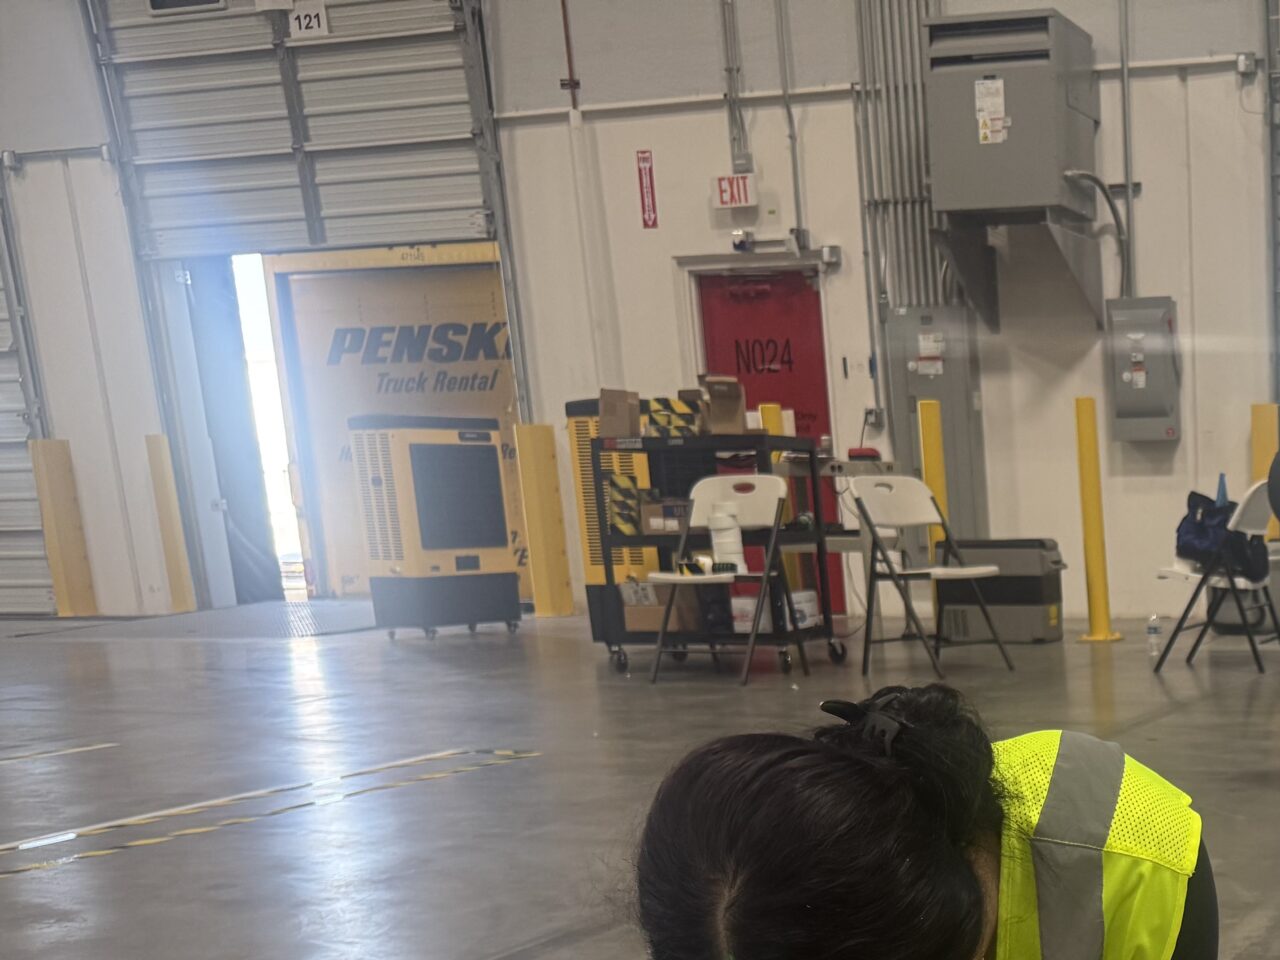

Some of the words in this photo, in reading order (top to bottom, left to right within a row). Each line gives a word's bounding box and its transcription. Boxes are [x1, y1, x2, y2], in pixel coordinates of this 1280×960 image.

[294, 12, 321, 31] 121
[717, 175, 749, 206] EXIT
[376, 371, 429, 394] Truck
[432, 368, 499, 392] Rental
